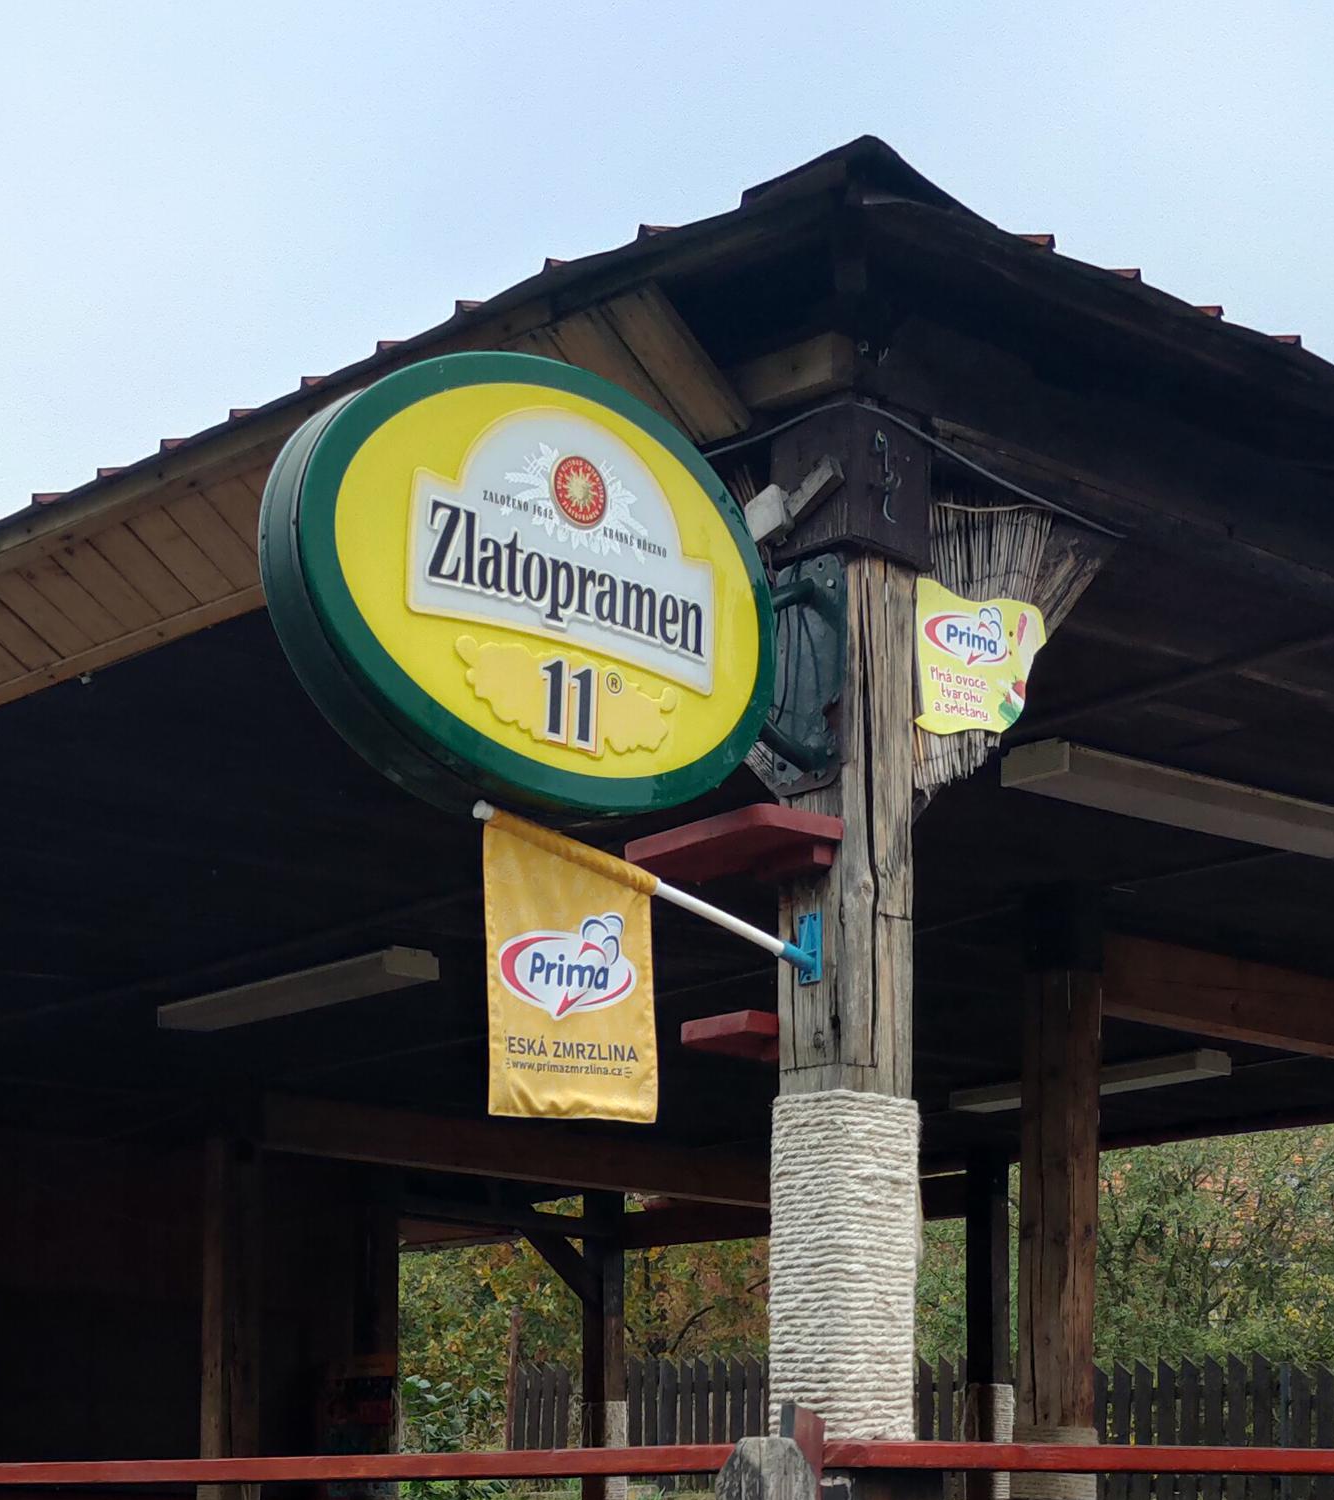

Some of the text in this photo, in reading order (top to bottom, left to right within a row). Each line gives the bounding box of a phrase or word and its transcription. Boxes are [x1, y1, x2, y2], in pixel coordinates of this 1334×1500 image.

[482, 489, 554, 520] ZALOŽENO 1642
[427, 499, 705, 658] Zlatopramen
[945, 622, 999, 656] Prima
[930, 665, 953, 683] Plná
[542, 659, 594, 744] 11
[941, 682, 983, 704] tvarohu
[934, 701, 989, 722] a smetany
[529, 950, 609, 991] Prima
[504, 1031, 639, 1063] ESKÁ ZMRZLINA
[511, 1059, 623, 1077] www.primazmrzlina.cz
